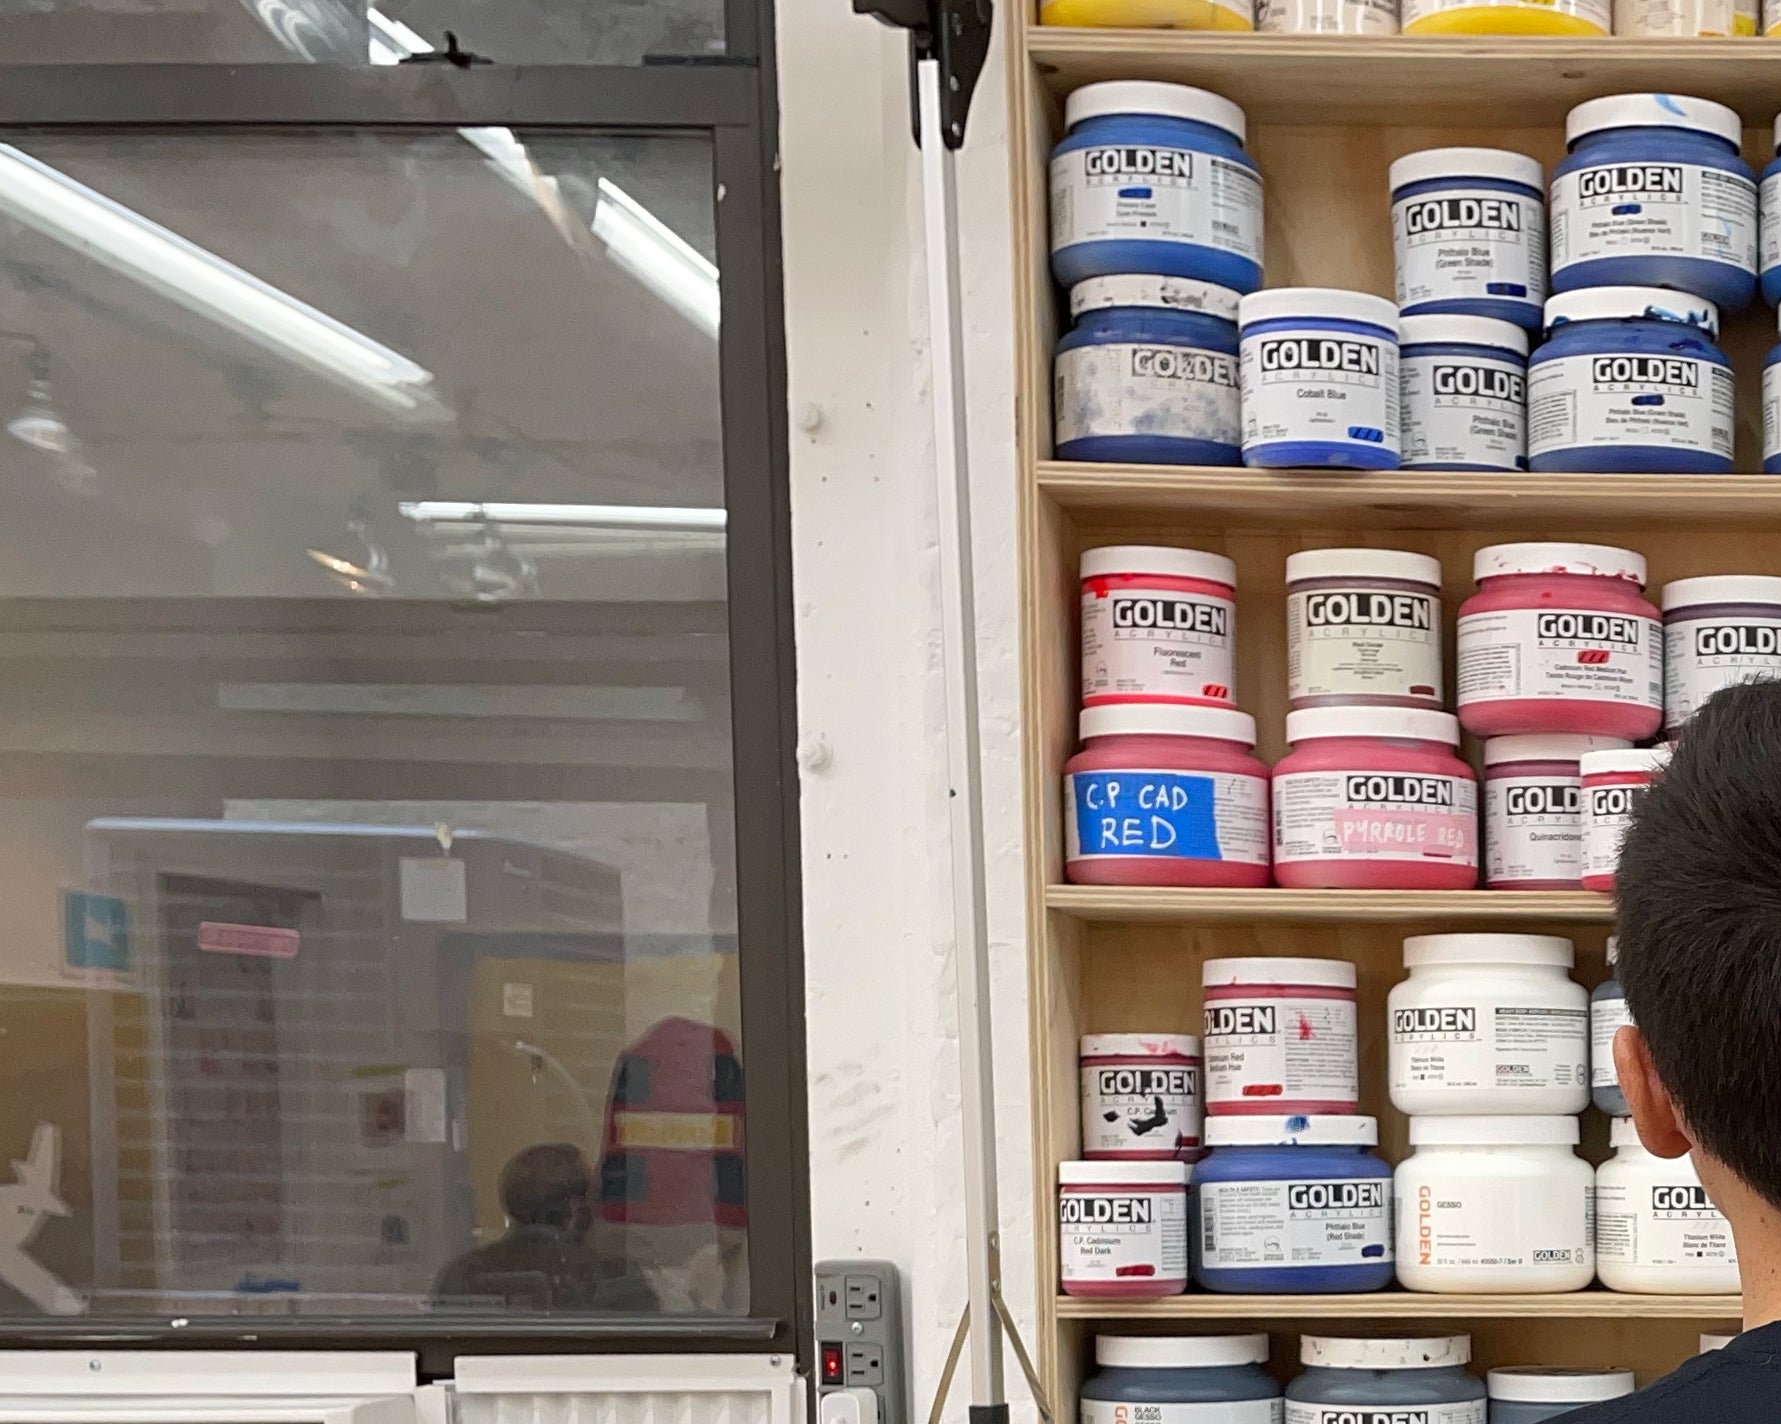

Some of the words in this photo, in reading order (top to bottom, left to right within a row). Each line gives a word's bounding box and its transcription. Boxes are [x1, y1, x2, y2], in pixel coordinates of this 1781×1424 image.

[1087, 150, 1191, 176] GOLDEN
[1581, 168, 1681, 197] GOLDEN
[1408, 200, 1519, 232] GOLDEN
[1262, 341, 1378, 374] GOLDEN
[1434, 367, 1526, 403] GOLDE
[1594, 358, 1697, 386] GOLDEN
[1297, 388, 1325, 398] Cobalt
[1327, 389, 1347, 400] Blue
[1114, 601, 1225, 634] GOLDEN
[1308, 594, 1429, 628] GOLDEN
[1539, 615, 1637, 642] GOLDEN
[1154, 647, 1201, 659] Fluorescent
[1170, 658, 1186, 667] Red
[1139, 784, 1188, 811] CAD
[1348, 777, 1451, 804] GOLDEN
[1508, 787, 1580, 813] GOLD
[1101, 815, 1176, 849] RED
[1343, 820, 1427, 844] PYRROLE
[1437, 826, 1464, 848] RED
[1205, 1007, 1273, 1034] OLDEN
[1396, 1009, 1474, 1032] GOLDEN
[1231, 1052, 1245, 1061] Red
[1101, 1071, 1195, 1093] GOLDEN
[1290, 1184, 1381, 1208] GOLDEN
[1436, 1201, 1462, 1209] GESSO
[1419, 1185, 1431, 1266] GOLDEN
[1535, 1251, 1570, 1261] GOLDEN
